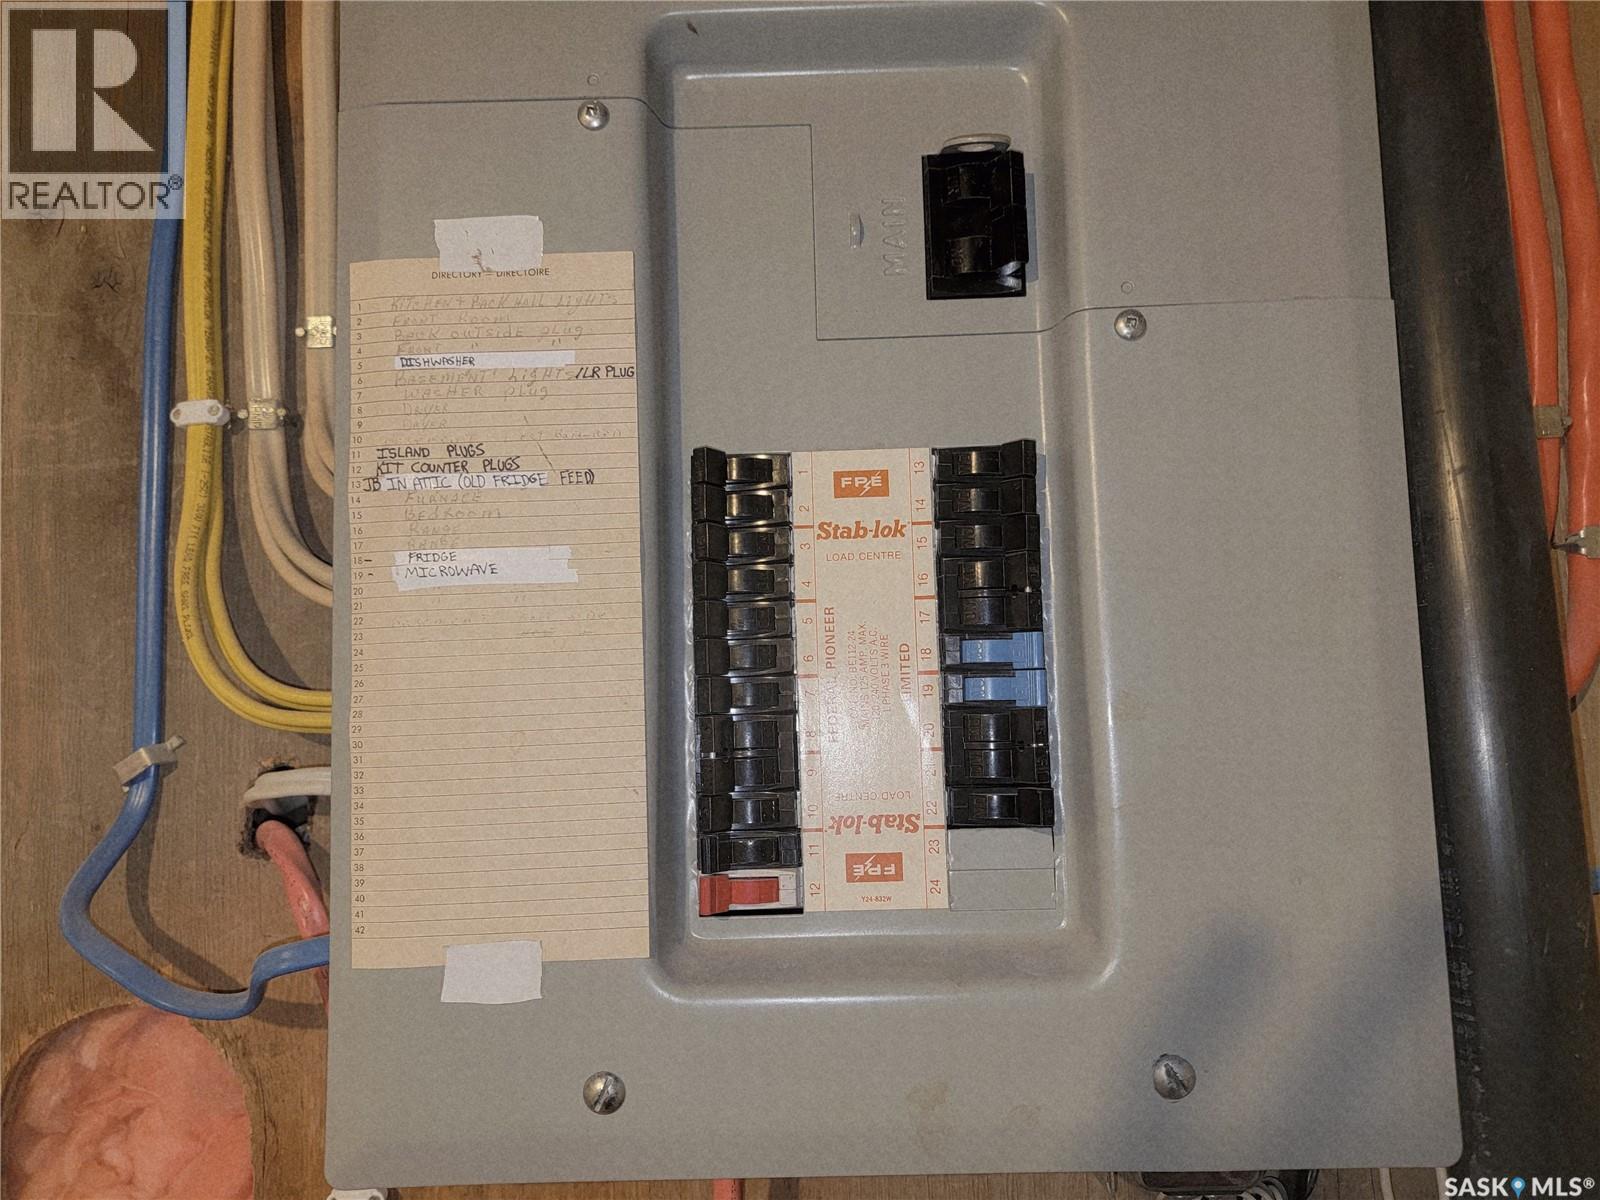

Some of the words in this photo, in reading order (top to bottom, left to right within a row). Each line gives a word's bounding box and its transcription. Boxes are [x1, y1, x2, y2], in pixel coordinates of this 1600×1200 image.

[881, 199, 907, 276] MAIN
[400, 356, 476, 368] DISHWASHER
[605, 366, 635, 379] PLUG
[376, 446, 430, 460] ISLAND
[446, 443, 486, 458] PLUGS
[411, 460, 469, 474] COUNTER
[482, 456, 521, 472] PLUGS
[914, 461, 925, 474] 13
[387, 477, 407, 490] IN
[412, 474, 452, 489] ATTIC
[458, 472, 486, 490] (OLD
[494, 472, 548, 487] FRIDGE
[560, 469, 596, 486] FEED)
[915, 499, 926, 511] 14
[816, 519, 907, 540] Stab-lok
[917, 536, 928, 550] 15
[408, 551, 457, 563] FRIDGE
[826, 553, 855, 562] LOAD
[859, 551, 901, 561] CENTRE
[405, 563, 499, 579] MICROWAVE
[918, 573, 929, 586] 16
[920, 611, 931, 625] 17
[824, 606, 836, 670] PIONEER
[879, 635, 889, 660] WIRE
[921, 647, 932, 661] 18
[353, 664, 364, 672] 25
[869, 649, 879, 681] VOLTS
[881, 671, 891, 705] PHASE
[922, 684, 934, 698] 19
[834, 792, 878, 801] CENTRE
[881, 791, 911, 800] LOAD
[353, 802, 364, 810] 34
[808, 804, 819, 818] 10
[926, 800, 938, 815] 22
[353, 817, 364, 825] 35
[829, 813, 921, 835] Stab-lok
[809, 843, 819, 857] 11
[929, 839, 940, 855] 23
[354, 879, 365, 887] 39
[810, 883, 821, 897] 12
[930, 879, 942, 894] 24
[355, 894, 365, 902] 40
[355, 910, 364, 918] 41
[355, 926, 365, 934] 42
